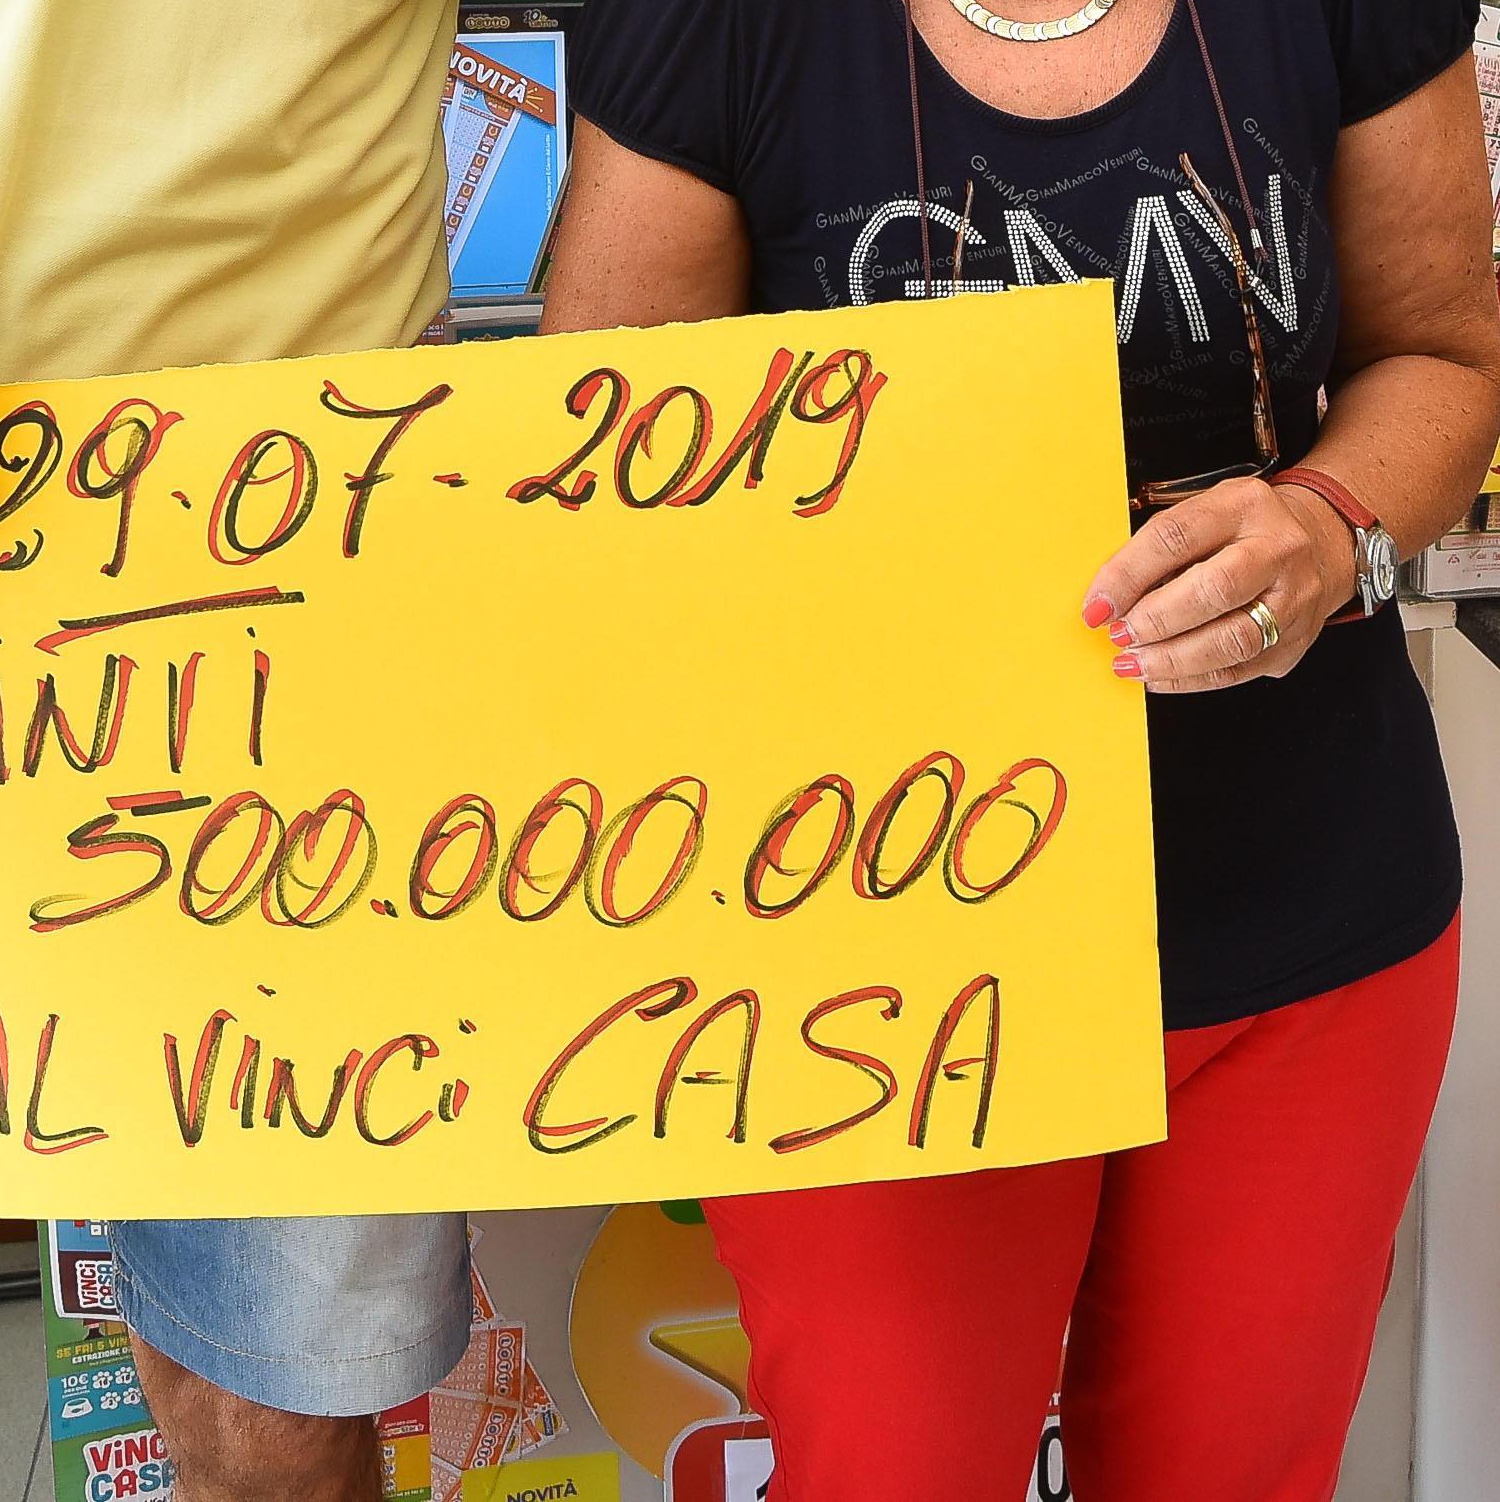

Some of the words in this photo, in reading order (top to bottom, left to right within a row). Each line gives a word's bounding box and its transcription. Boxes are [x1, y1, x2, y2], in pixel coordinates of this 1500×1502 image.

[465, 16, 510, 30] LOTTO
[29, 748, 1069, 932] 500.000.000
[525, 973, 1004, 1158] CASA
[55, 1347, 72, 1360] SE
[74, 1344, 94, 1357] FAI
[71, 1350, 121, 1364] ESTRAZIONE
[495, 1332, 515, 1398] LOTTO
[61, 1373, 90, 1390] 10€
[472, 1409, 508, 1468] LOTTO
